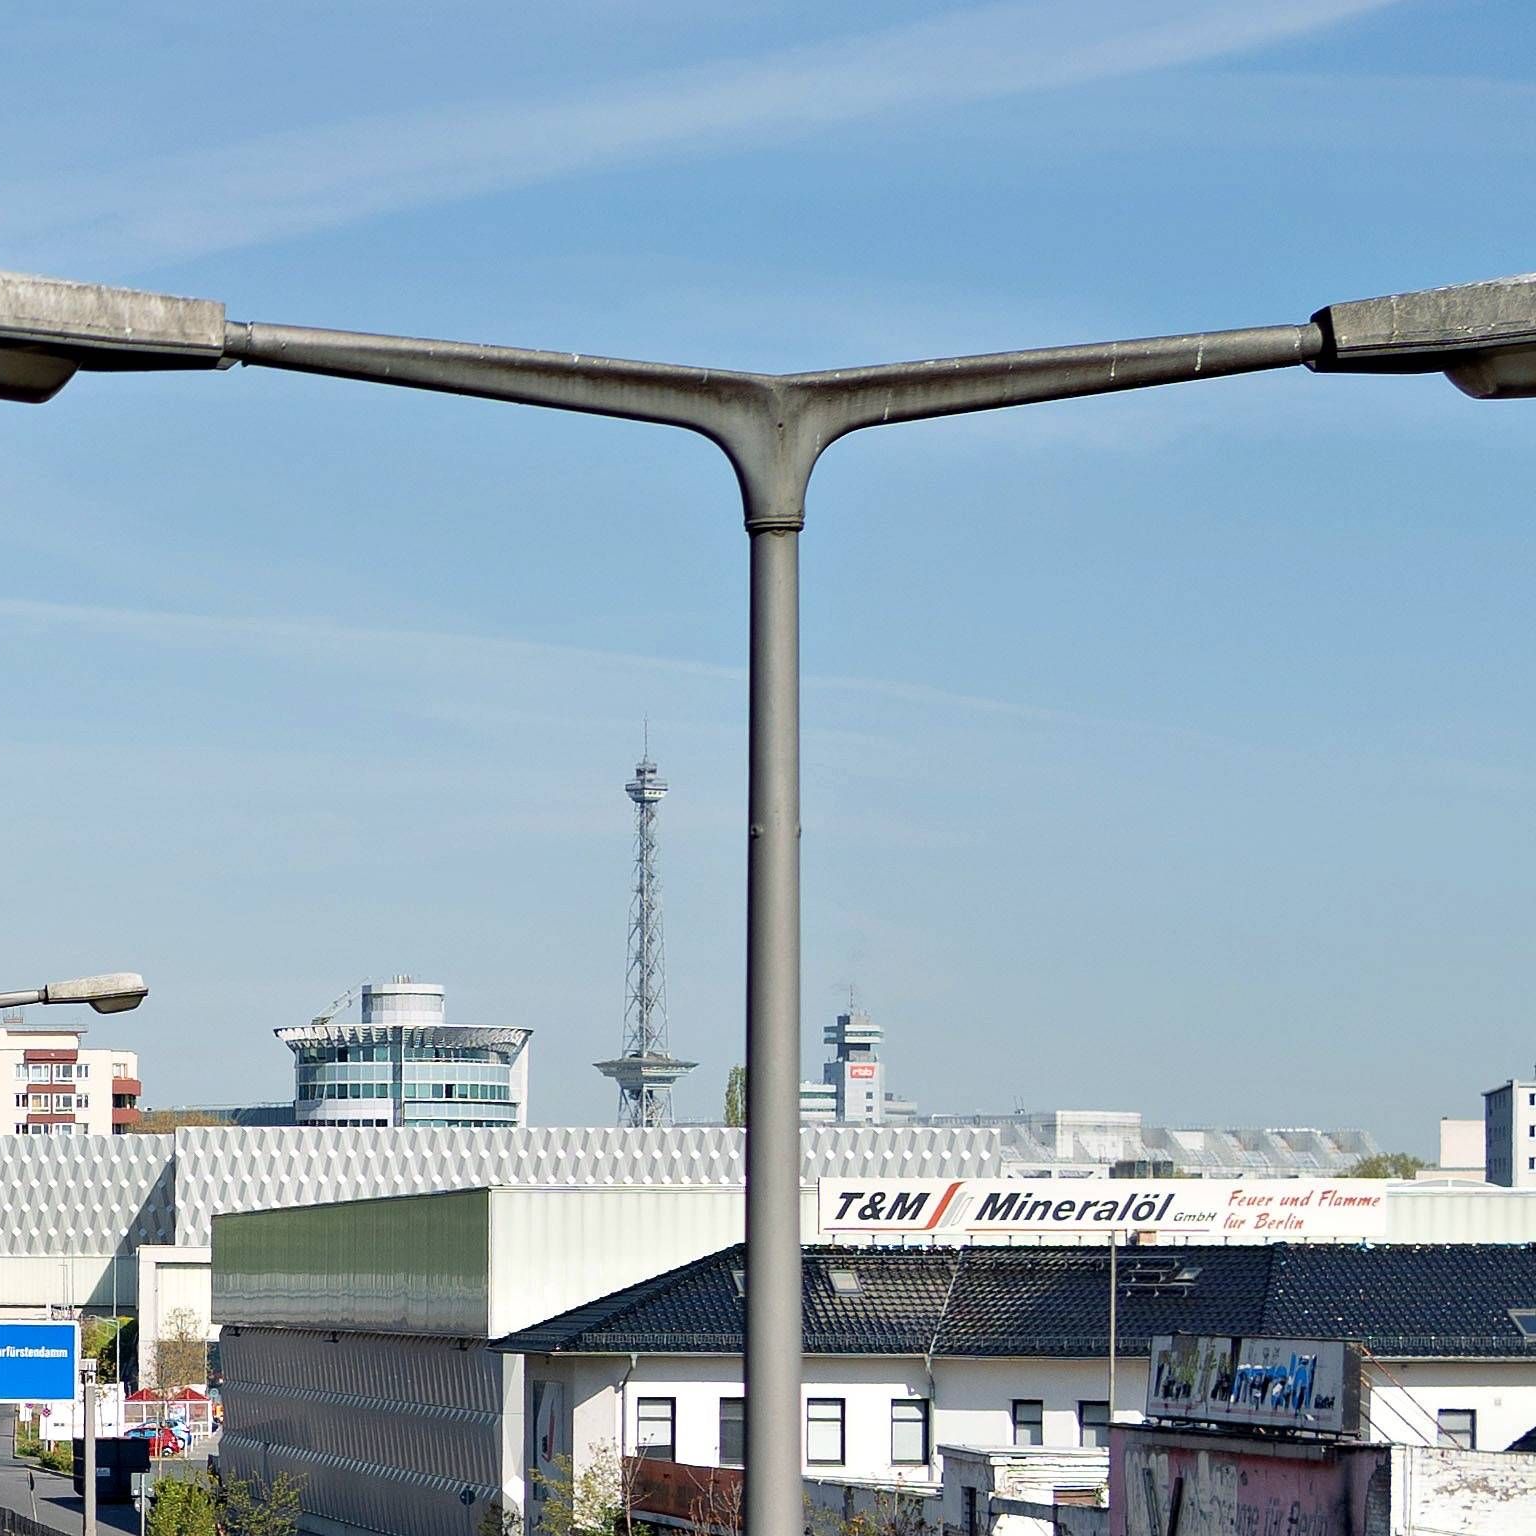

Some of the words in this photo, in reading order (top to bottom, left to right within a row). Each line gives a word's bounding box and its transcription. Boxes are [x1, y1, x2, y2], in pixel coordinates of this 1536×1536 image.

[835, 1192, 931, 1221] T&M
[975, 1192, 1175, 1222] Mineralöl
[1173, 1212, 1217, 1222] GmbH
[1228, 1189, 1274, 1207] Feuer
[1279, 1190, 1314, 1207] und
[1318, 1189, 1381, 1207] Flamme
[1254, 1212, 1304, 1230] Berlin
